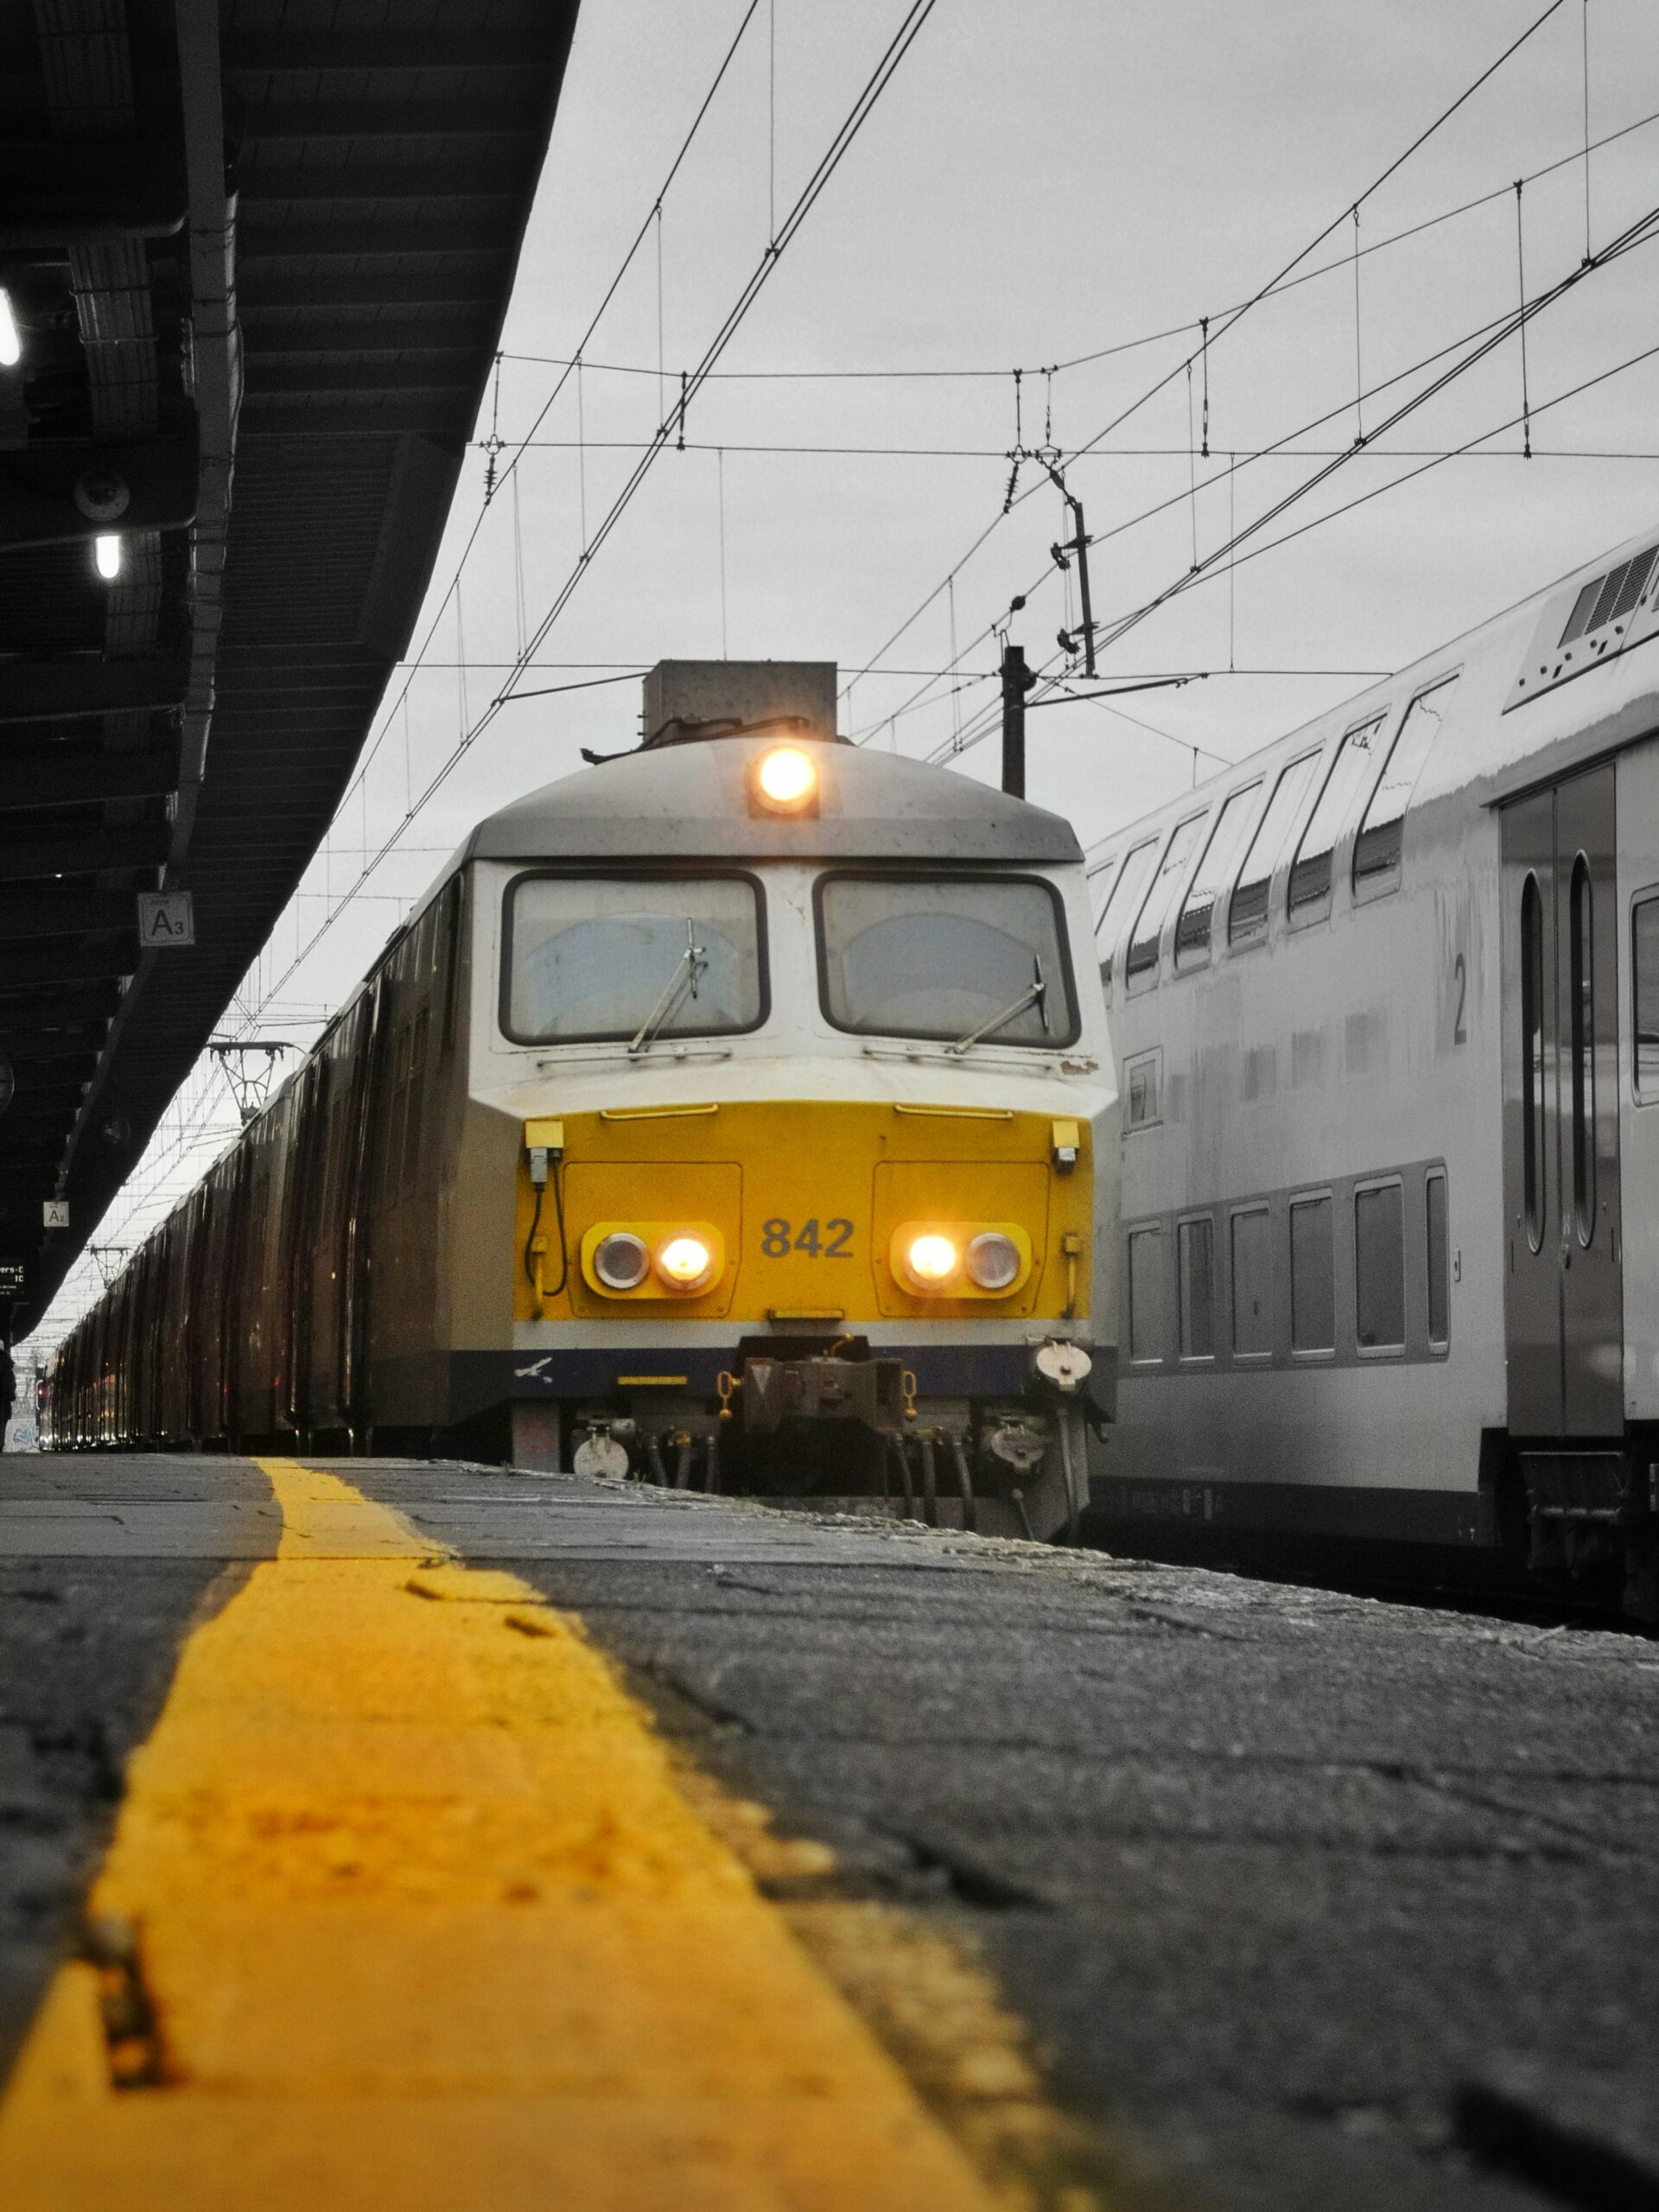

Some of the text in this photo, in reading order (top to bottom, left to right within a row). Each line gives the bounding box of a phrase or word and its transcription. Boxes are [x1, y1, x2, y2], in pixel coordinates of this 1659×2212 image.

[151, 909, 184, 936] A3
[1453, 952, 1467, 1046] 2
[762, 1218, 855, 1258] 842
